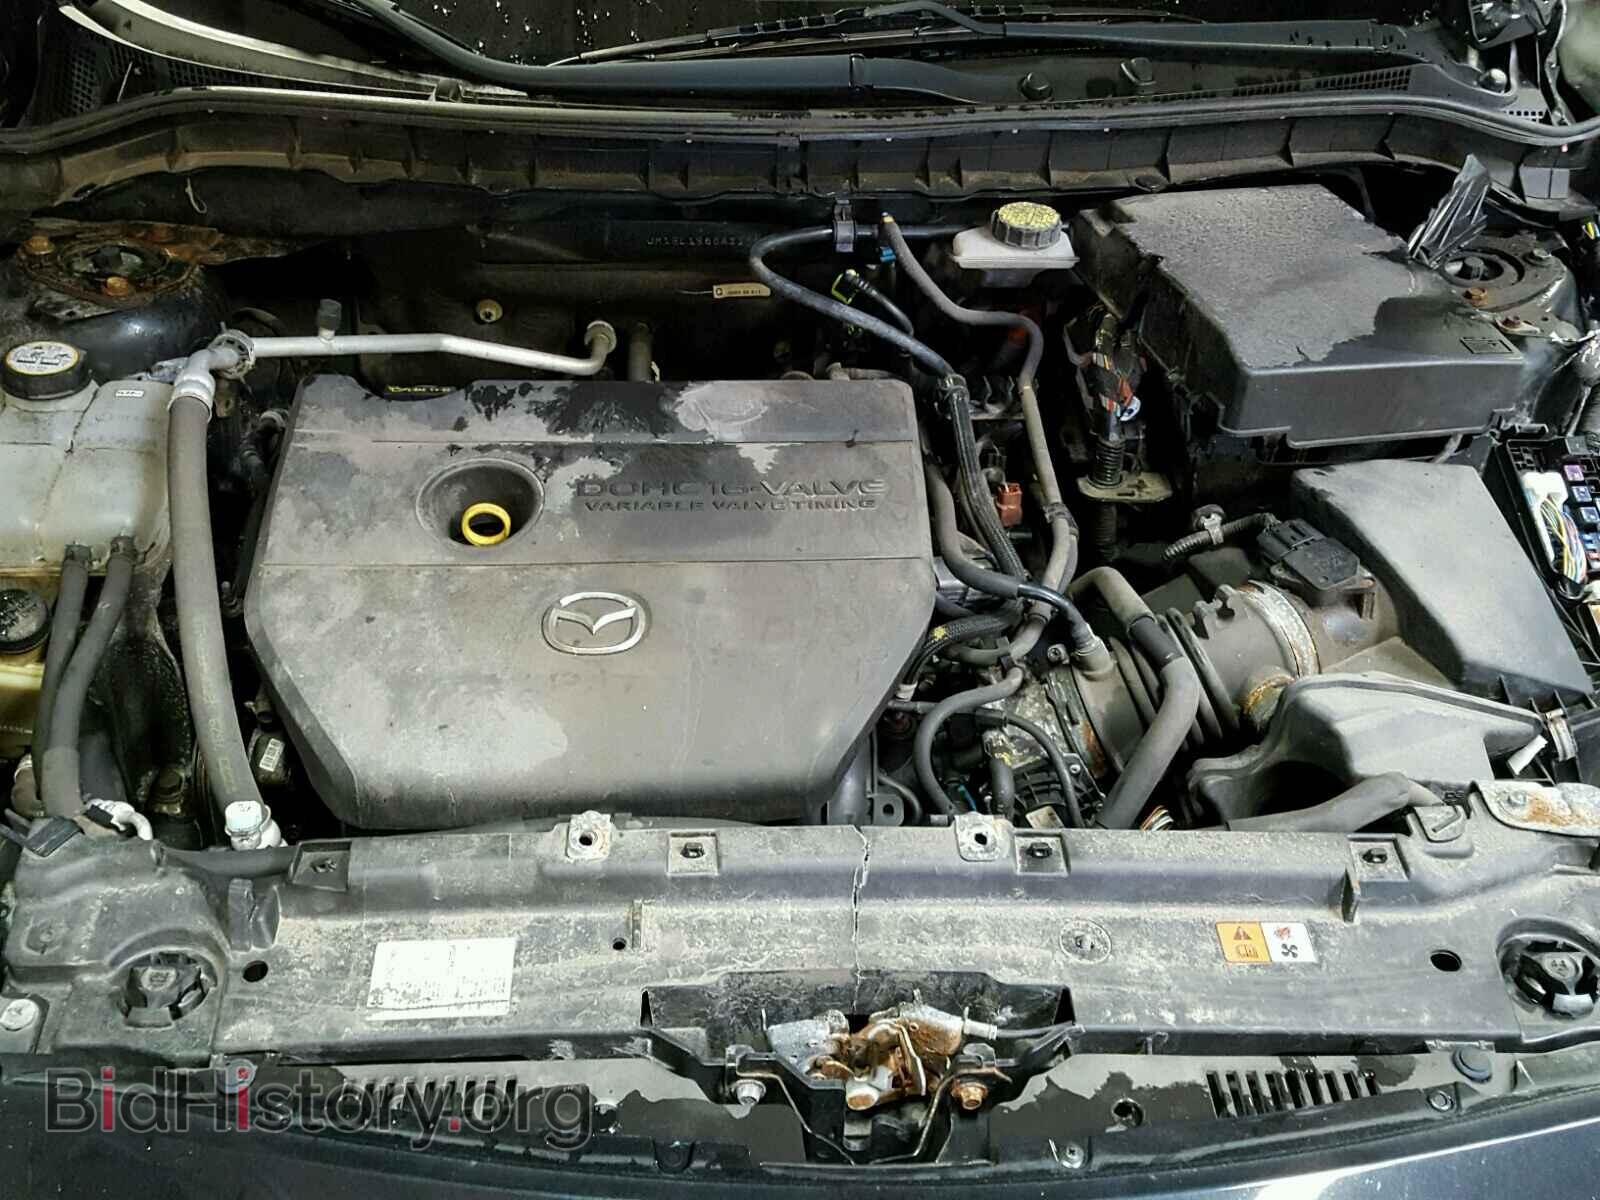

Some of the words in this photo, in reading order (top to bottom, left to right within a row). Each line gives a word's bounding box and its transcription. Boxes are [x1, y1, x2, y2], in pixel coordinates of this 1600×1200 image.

[575, 479, 700, 496] DOHC
[584, 500, 704, 512] VARIABLE
[712, 500, 786, 512] VALVE
[792, 499, 877, 511] TIMING
